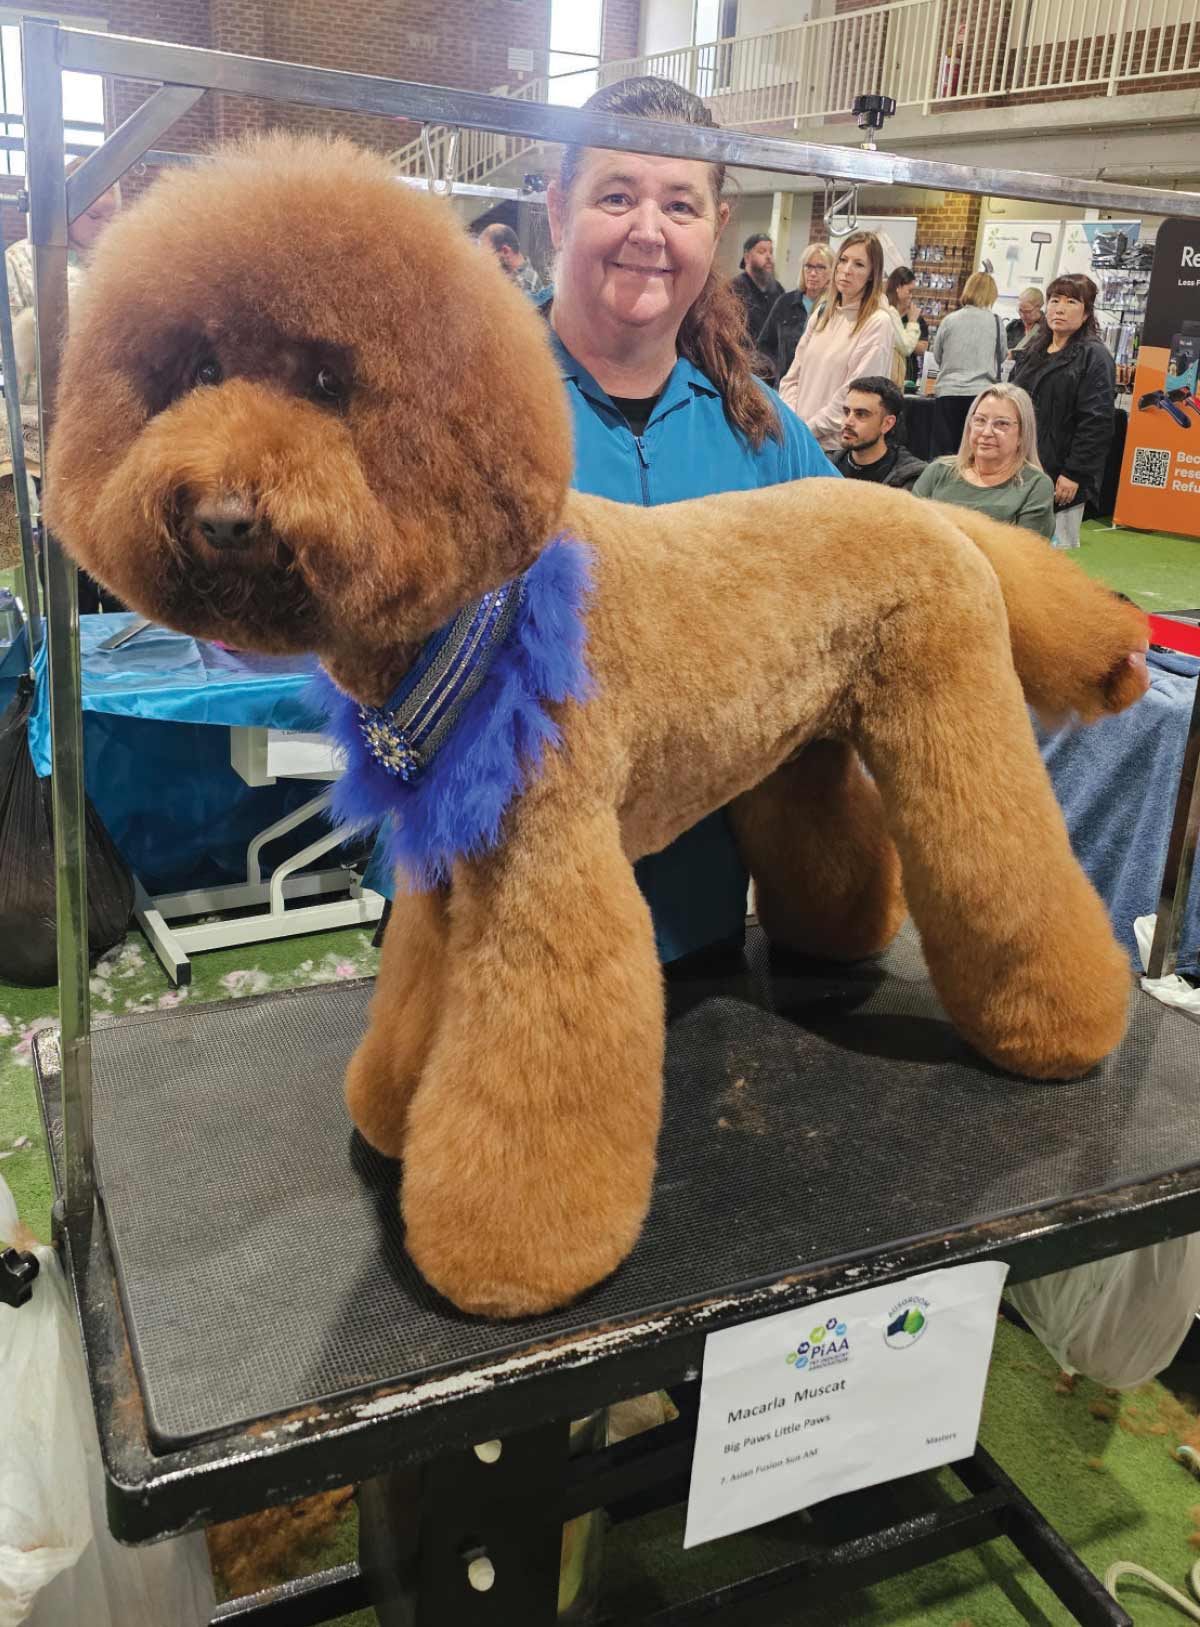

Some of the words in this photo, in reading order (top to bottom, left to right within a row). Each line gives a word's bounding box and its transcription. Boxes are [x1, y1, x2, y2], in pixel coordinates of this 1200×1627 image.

[793, 1379, 846, 1404] Muscat
[723, 1442, 741, 1455] Big
[743, 1432, 771, 1447] Paws
[774, 1422, 801, 1438] Little
[803, 1414, 831, 1429] Paws
